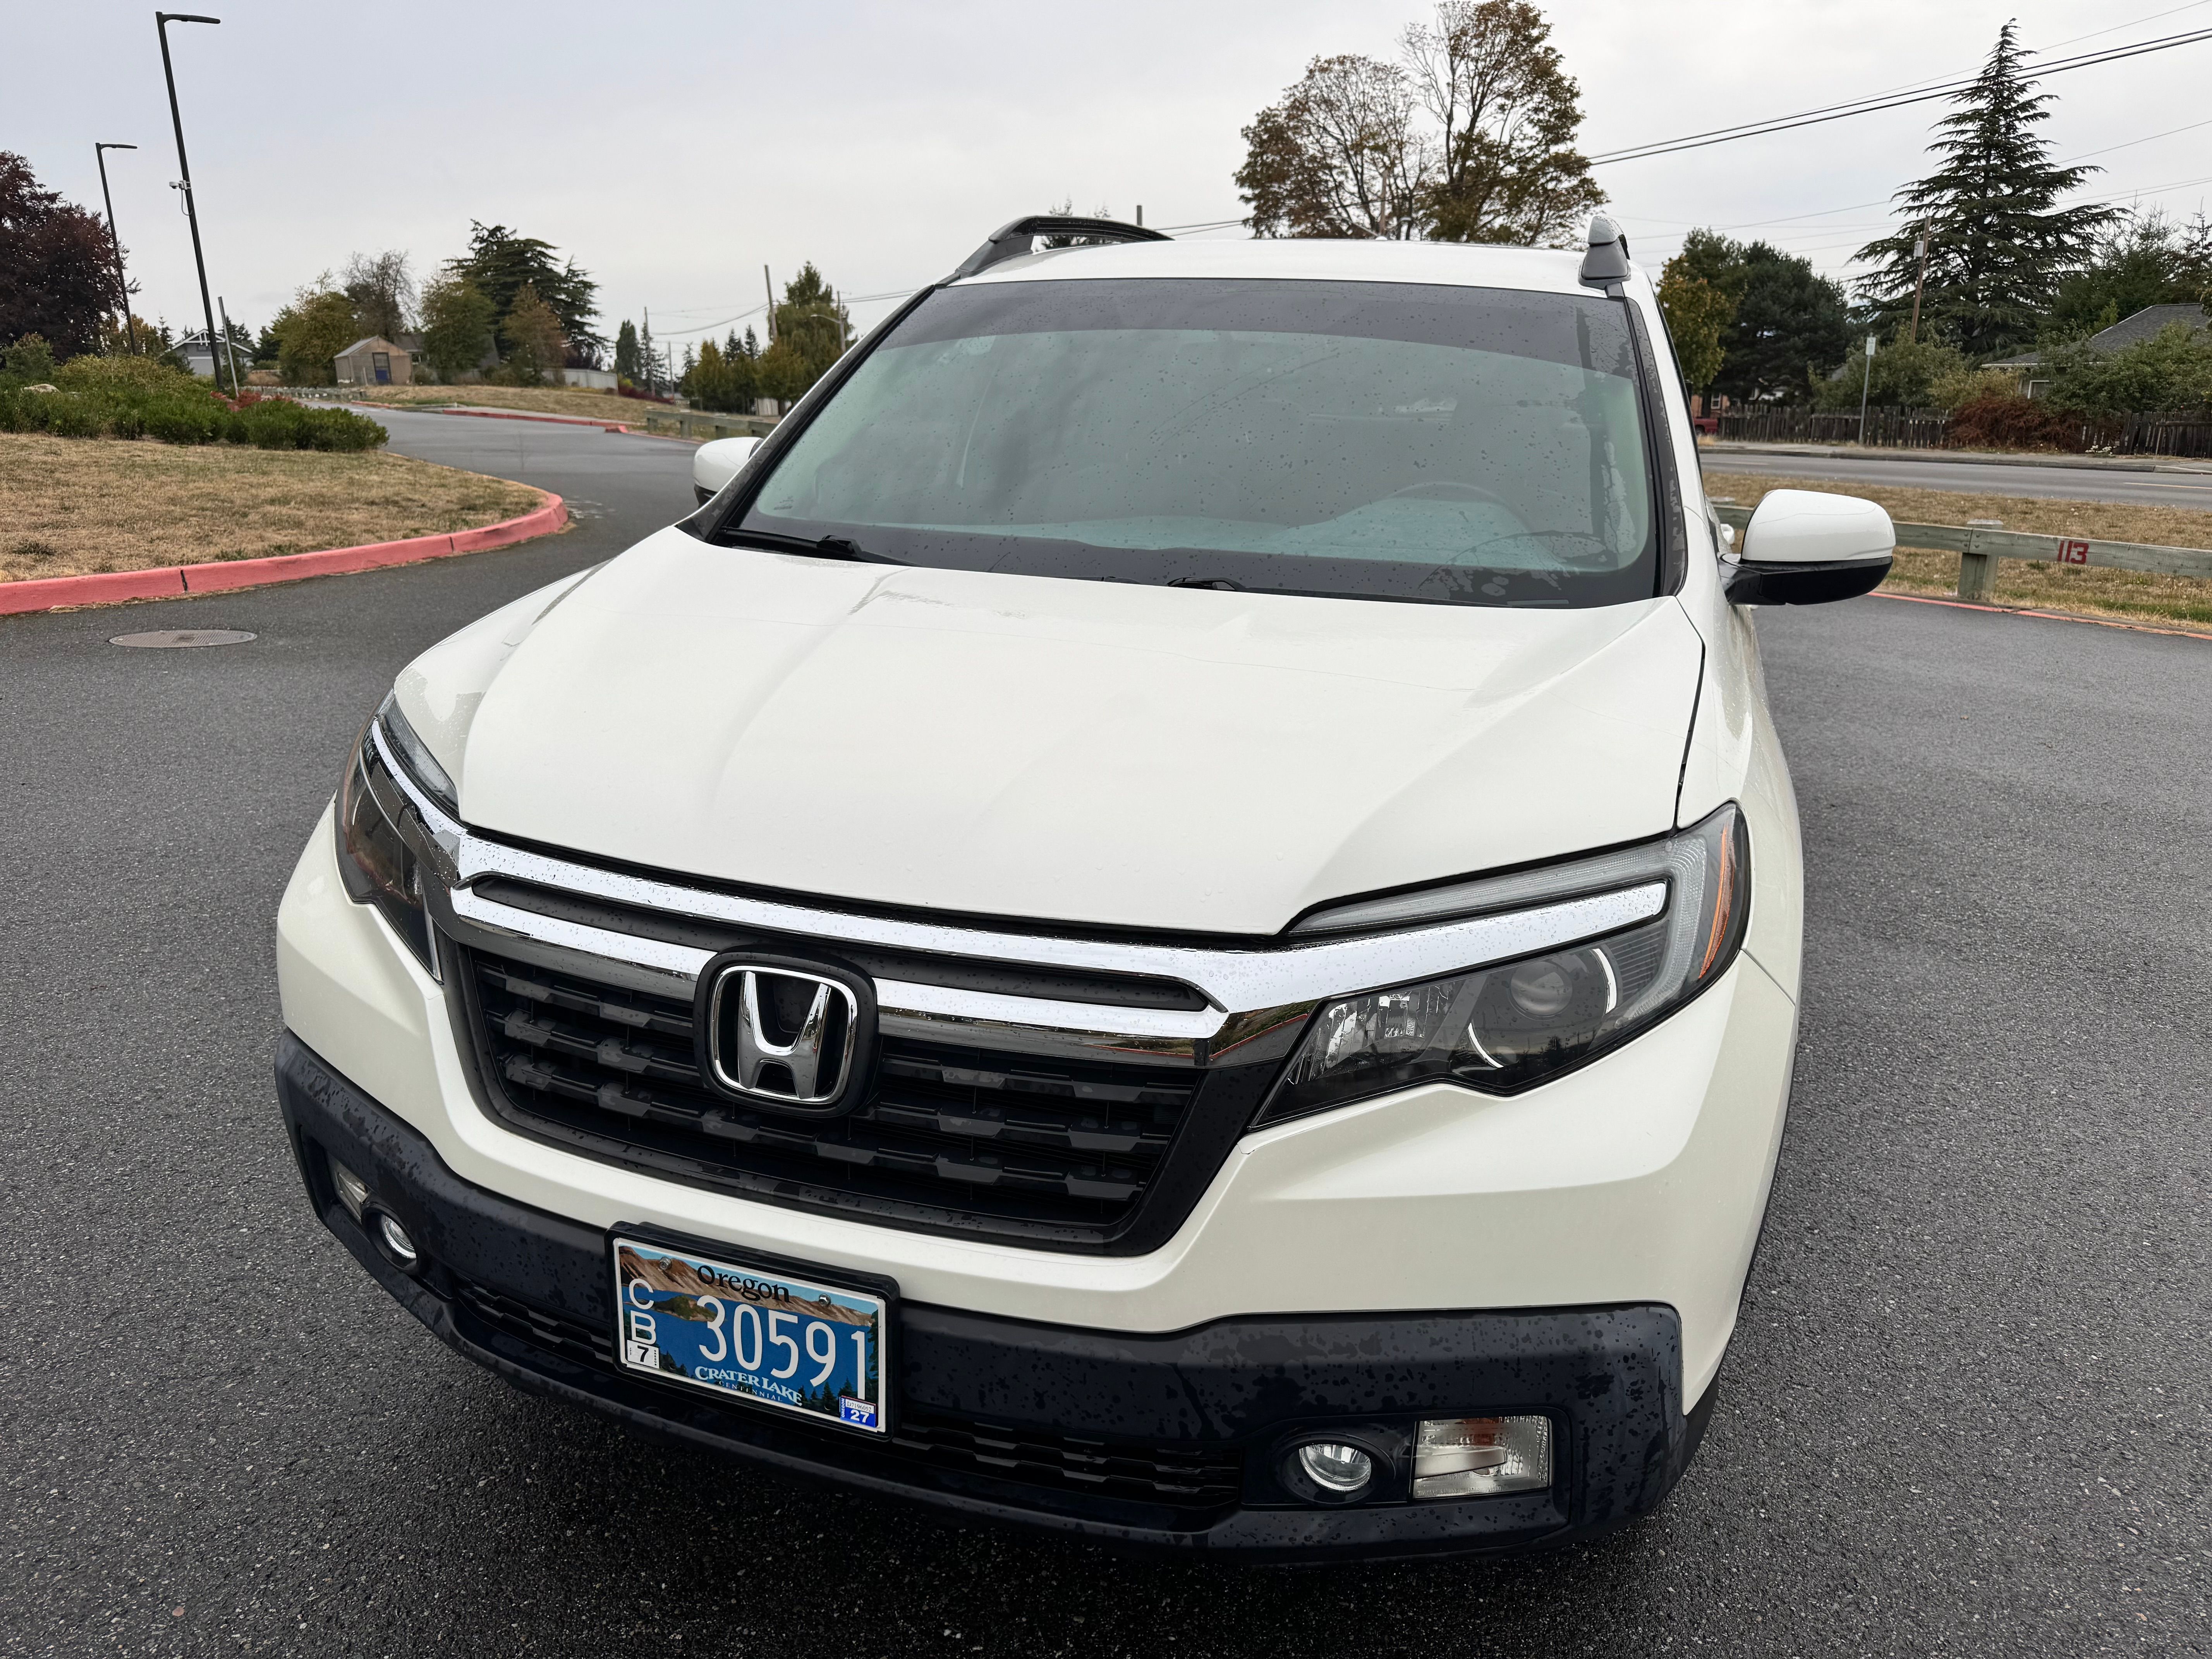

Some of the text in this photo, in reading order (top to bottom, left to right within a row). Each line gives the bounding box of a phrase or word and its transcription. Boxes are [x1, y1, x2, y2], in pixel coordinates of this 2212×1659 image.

[2057, 540, 2089, 565] 113
[697, 1265, 793, 1304] Oregon
[637, 1345, 649, 1362] 7
[697, 1295, 865, 1400] 30591
[695, 1366, 802, 1407] CRATER LAKE
[719, 1381, 783, 1402] CENTENNIAL
[847, 1401, 872, 1412] D7196052
[850, 1409, 869, 1423] 27
